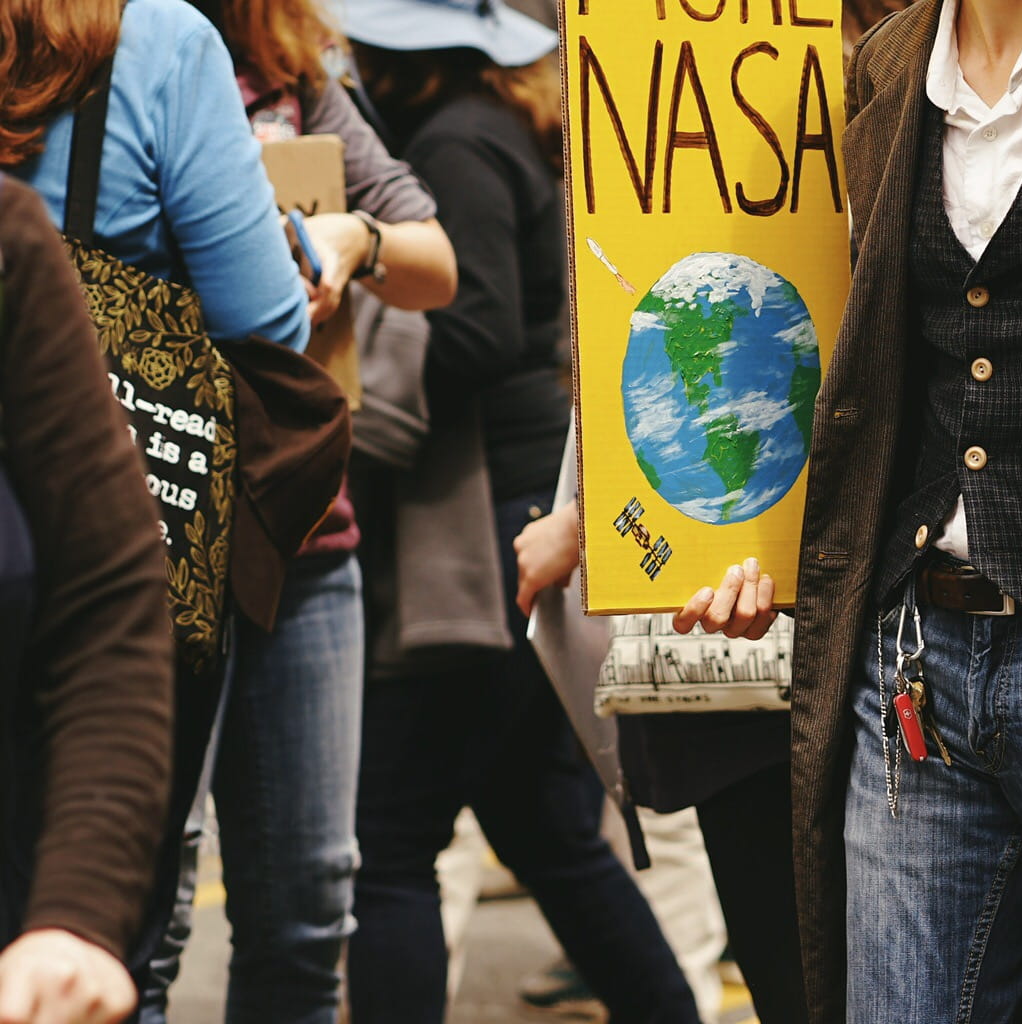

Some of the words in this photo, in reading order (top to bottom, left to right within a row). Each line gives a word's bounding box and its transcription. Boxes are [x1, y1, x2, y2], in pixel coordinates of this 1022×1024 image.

[578, 35, 844, 217] NASA
[145, 431, 181, 465] is
[187, 451, 209, 475] a
